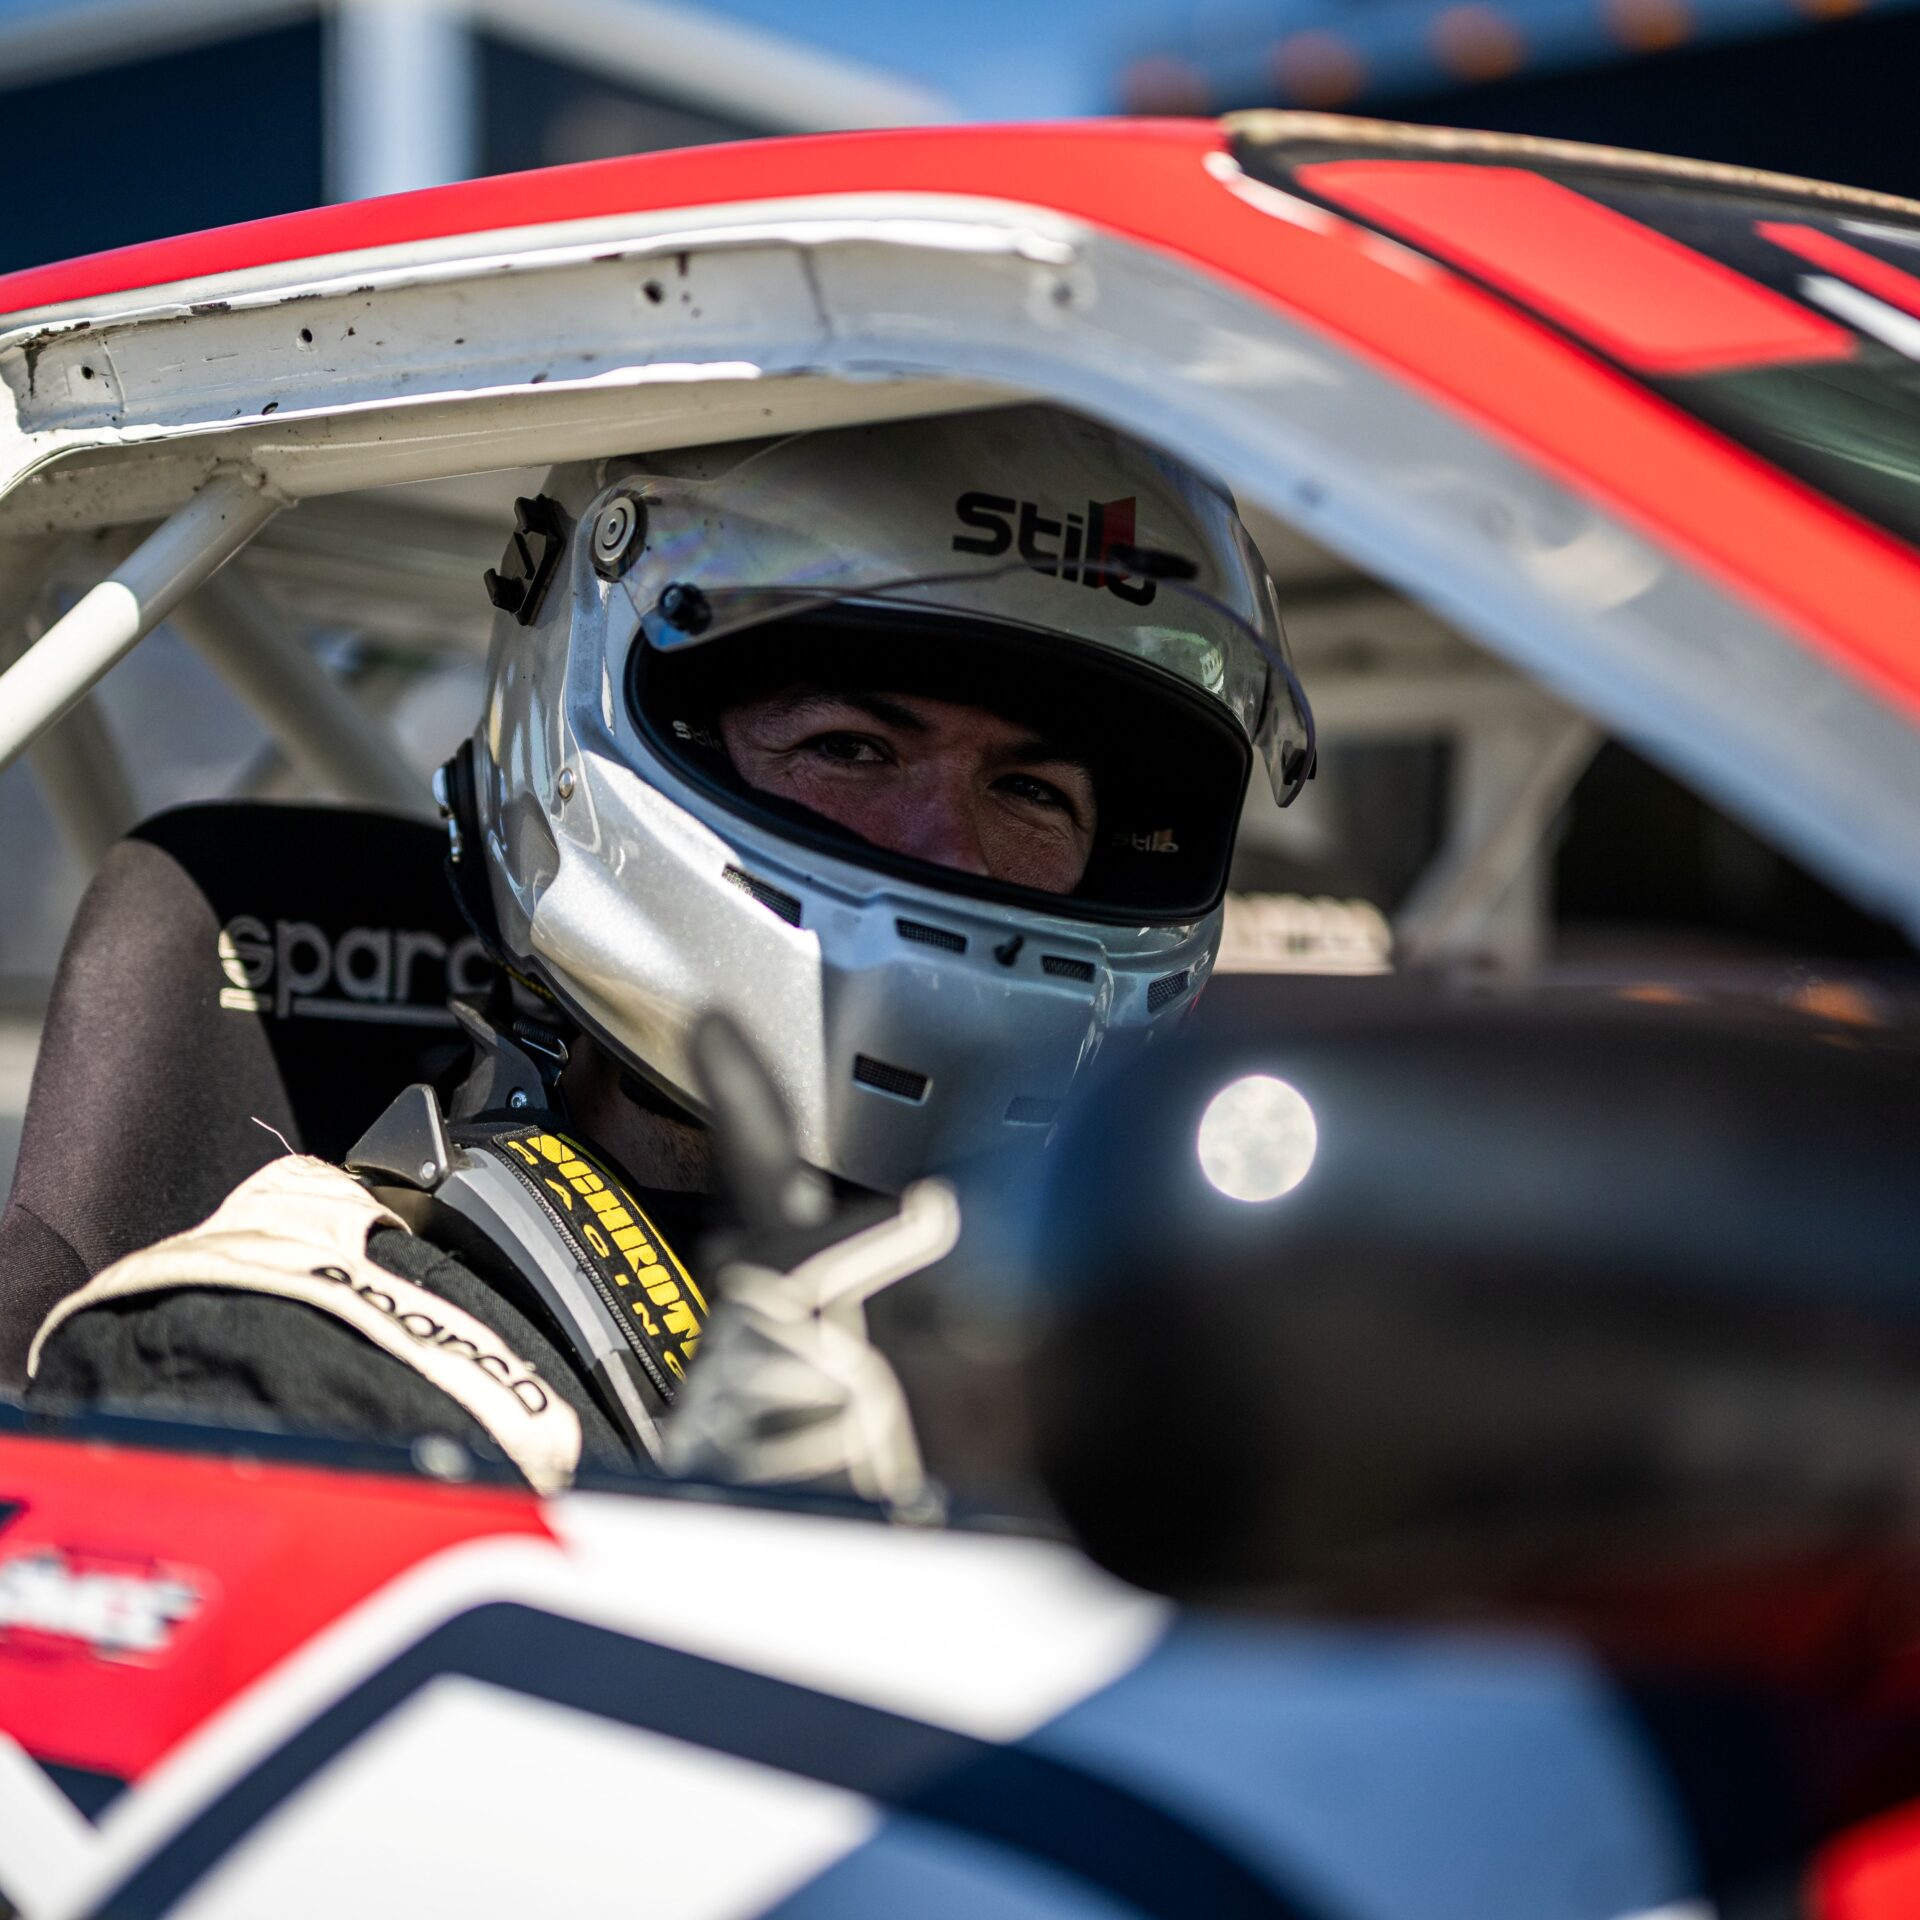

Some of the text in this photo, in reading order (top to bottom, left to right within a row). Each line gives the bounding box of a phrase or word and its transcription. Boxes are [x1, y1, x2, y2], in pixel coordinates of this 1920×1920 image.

[218, 914, 500, 1021] sparc
[507, 1140, 688, 1385] RACING
[526, 1134, 703, 1361] SCHROT
